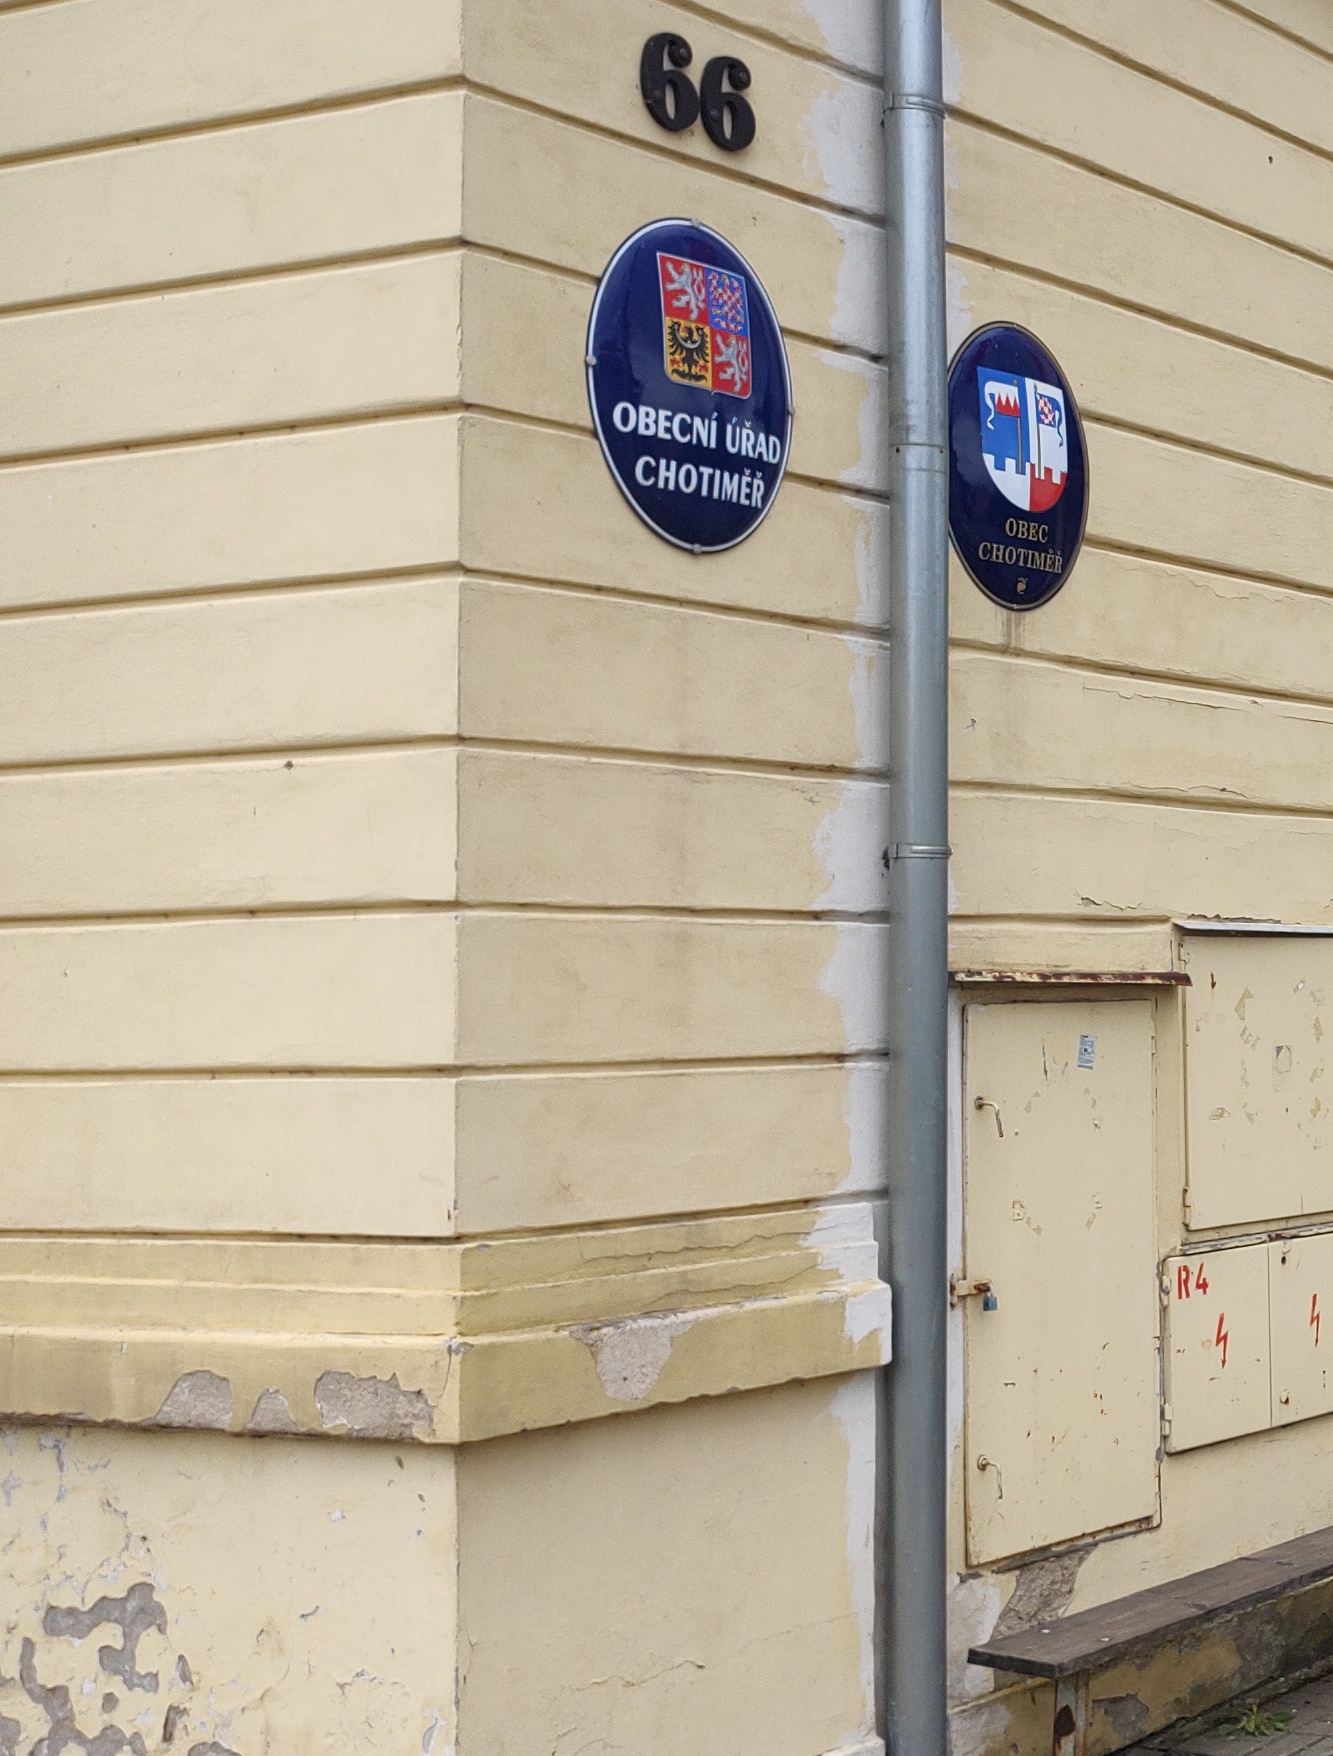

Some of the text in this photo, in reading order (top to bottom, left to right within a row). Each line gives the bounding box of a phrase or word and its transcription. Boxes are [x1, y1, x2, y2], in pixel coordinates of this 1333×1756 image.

[640, 32, 756, 152] 66
[613, 401, 781, 464] OBECNÍ ÚŘAD
[635, 456, 764, 508] CHOTIMĚŘ
[1005, 517, 1049, 543] OBEC
[978, 541, 1063, 574] CHOTIMĚŘ
